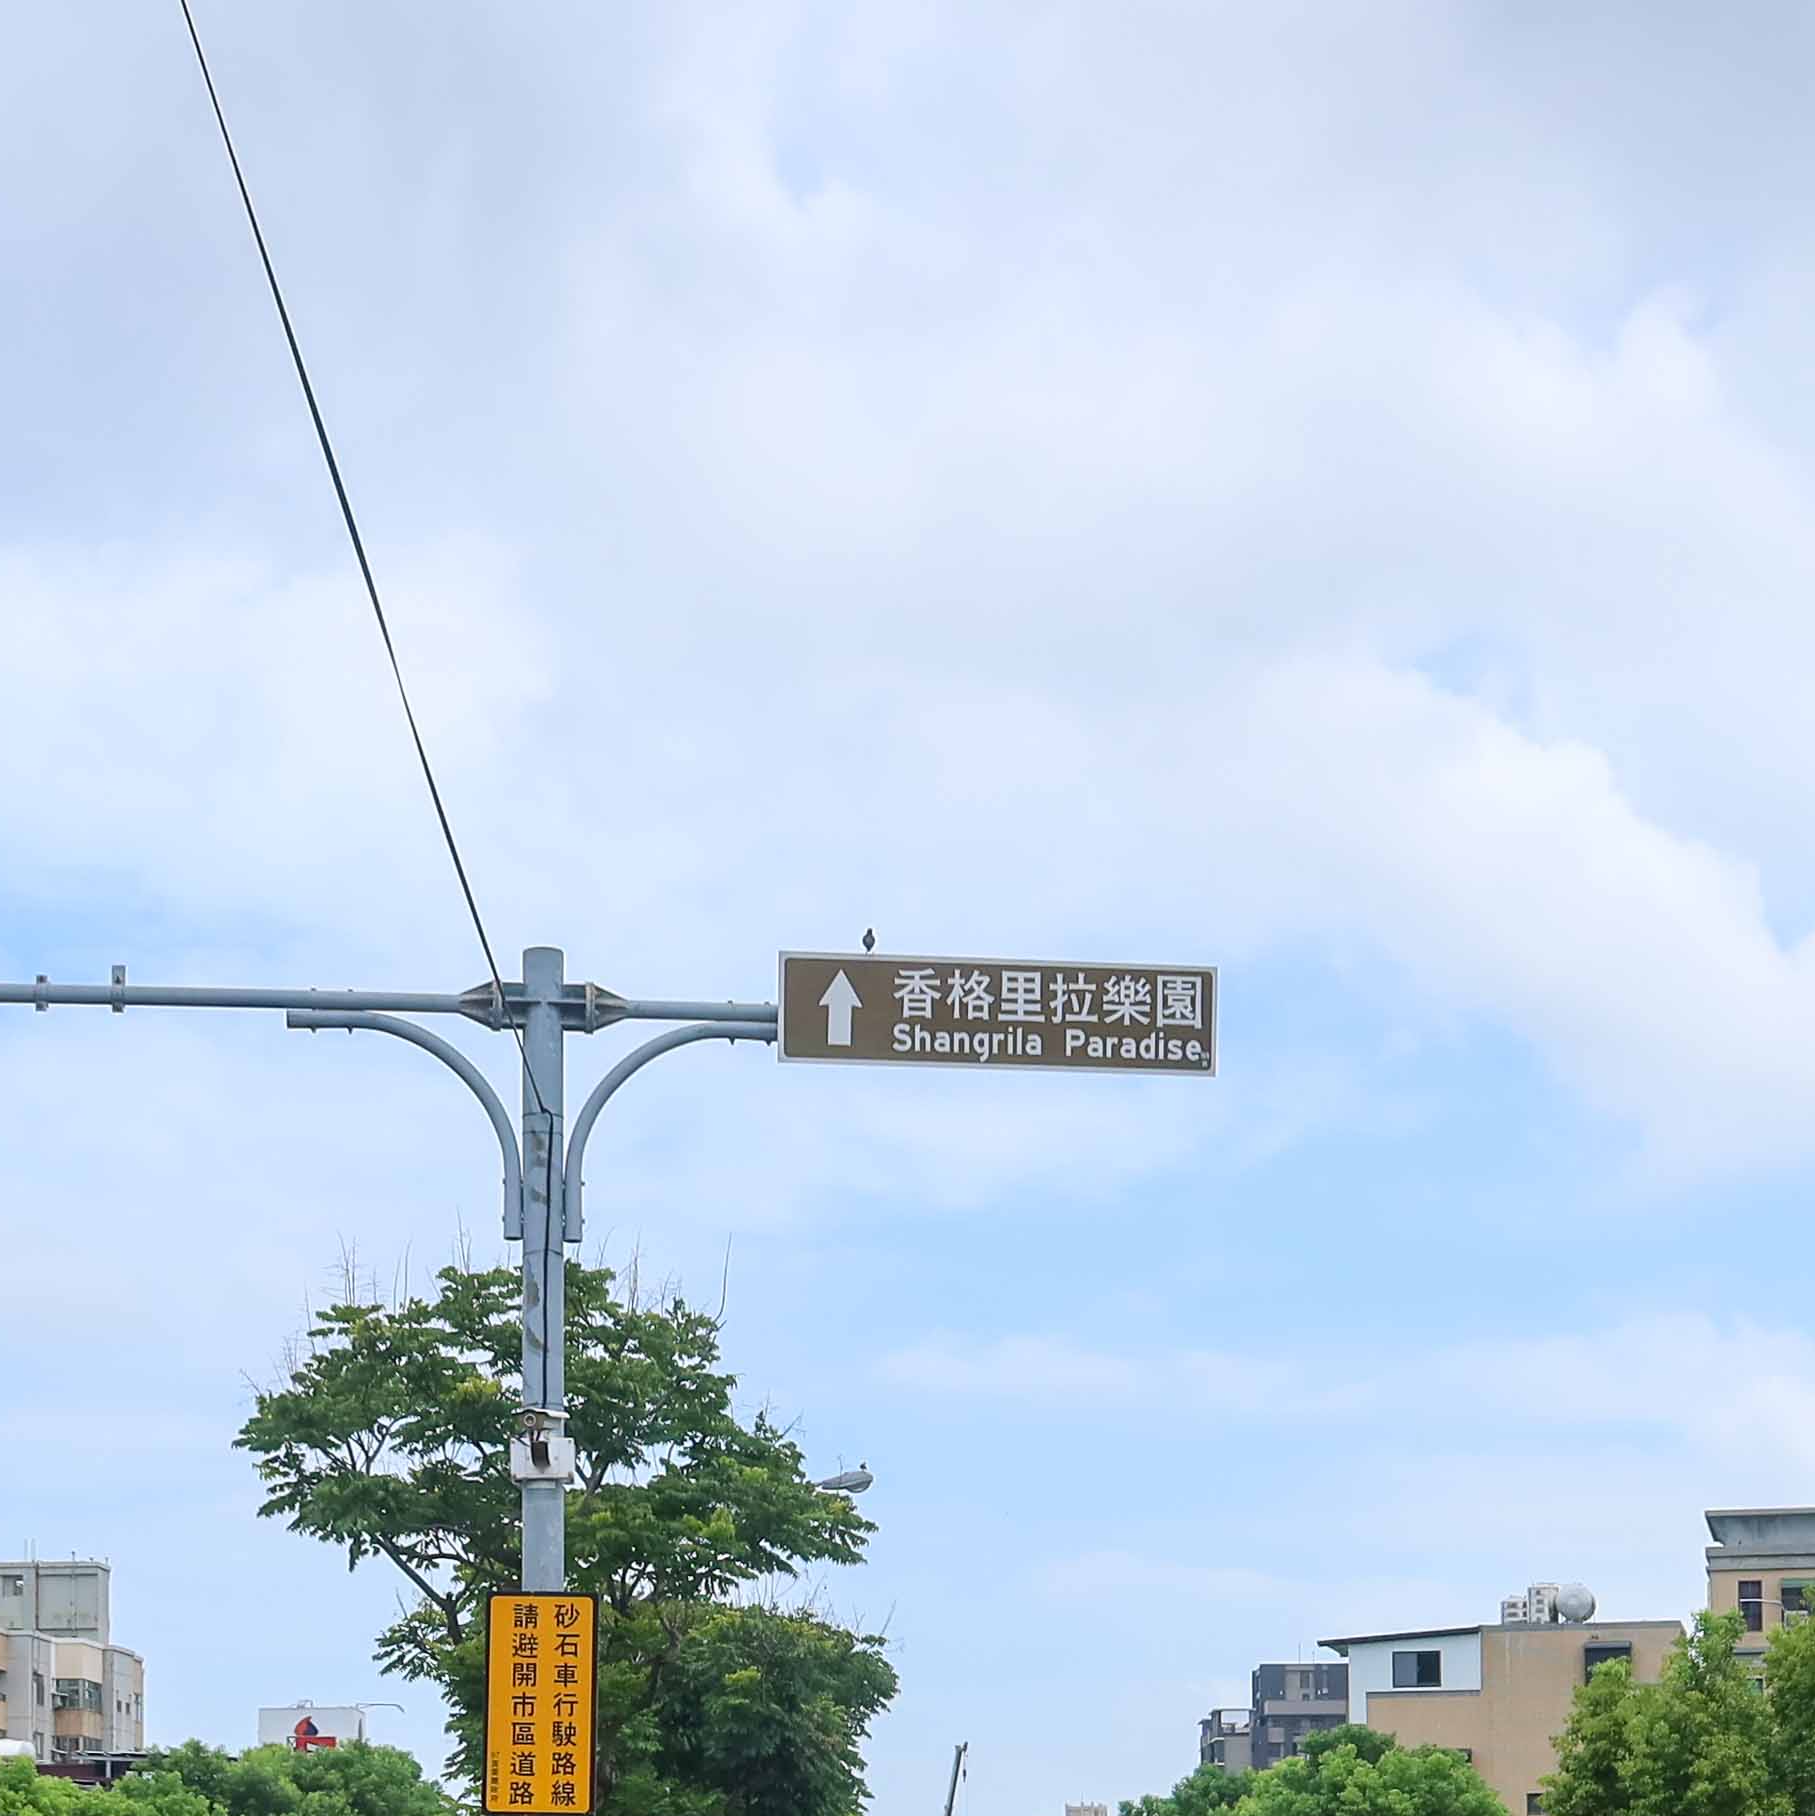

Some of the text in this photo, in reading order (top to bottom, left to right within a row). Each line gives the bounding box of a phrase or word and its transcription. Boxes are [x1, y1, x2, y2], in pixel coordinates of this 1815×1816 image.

[892, 1023, 1042, 1062] Shangrila
[1065, 1028, 1202, 1062] Paradise
[893, 968, 1203, 1030] 香格里拉樂園
[509, 1603, 539, 1806] 請避開市區道路
[550, 1603, 581, 1807] 砂石車行駛路線
